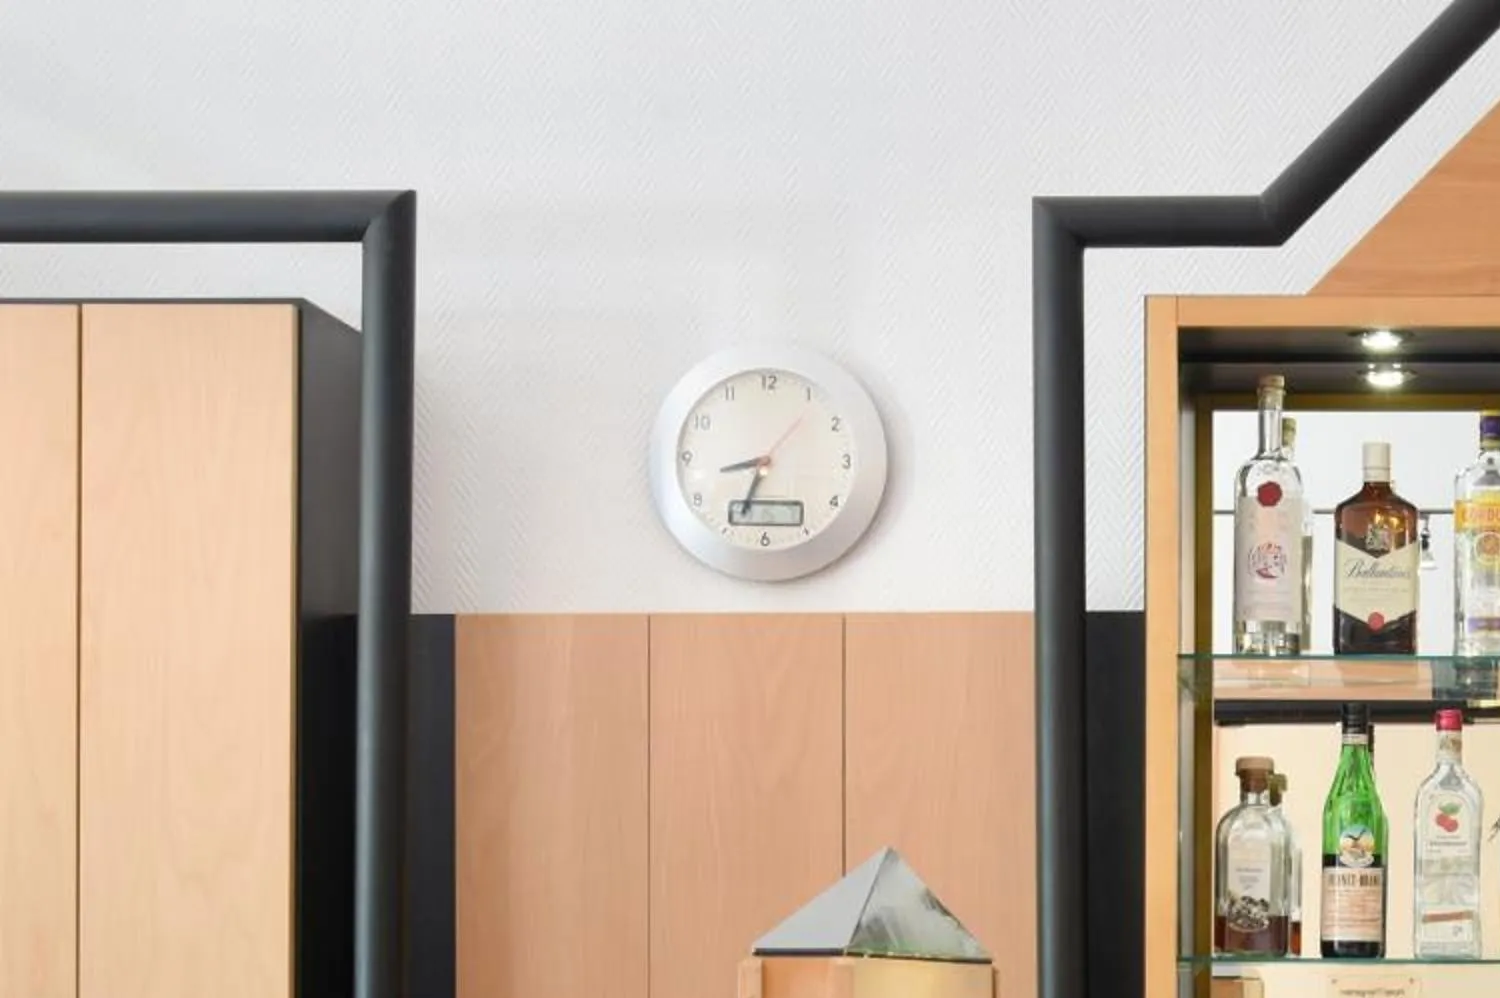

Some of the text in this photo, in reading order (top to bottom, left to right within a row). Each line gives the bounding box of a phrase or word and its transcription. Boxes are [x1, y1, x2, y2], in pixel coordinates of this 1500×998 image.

[761, 375, 777, 390] 12
[725, 386, 735, 400] 11
[694, 415, 711, 430] 10
[831, 416, 841, 432] 2
[681, 449, 693, 466] 9
[841, 454, 851, 470] 3
[692, 493, 703, 507] 8
[760, 531, 771, 546] 6
